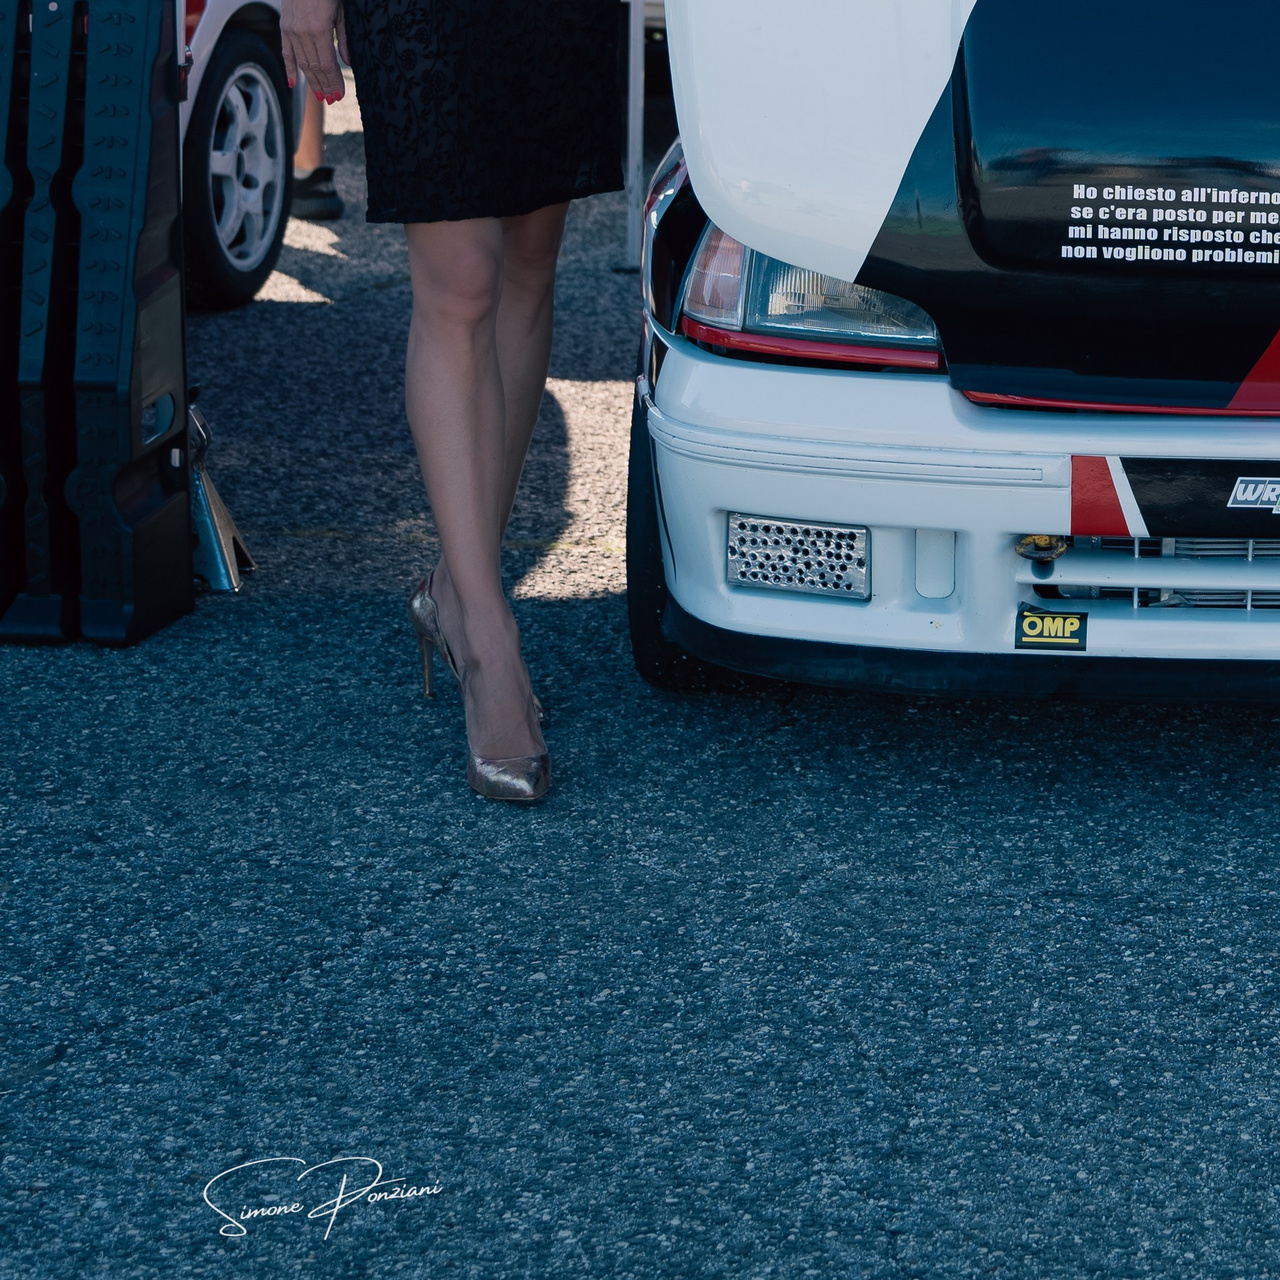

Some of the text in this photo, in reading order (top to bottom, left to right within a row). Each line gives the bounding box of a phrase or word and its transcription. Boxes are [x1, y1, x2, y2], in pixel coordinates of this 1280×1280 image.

[1072, 184, 1098, 200] Ho
[1102, 185, 1176, 202] chiesto
[1070, 206, 1094, 219] se
[1098, 205, 1147, 220] c'era
[1152, 208, 1207, 222] posto
[1212, 210, 1245, 224] per
[1068, 224, 1093, 238] mi
[1098, 225, 1158, 241] hanno
[1163, 227, 1244, 243] risposto
[1061, 245, 1098, 258] non
[1102, 245, 1187, 261] vogliono
[1022, 616, 1080, 637] OMP
